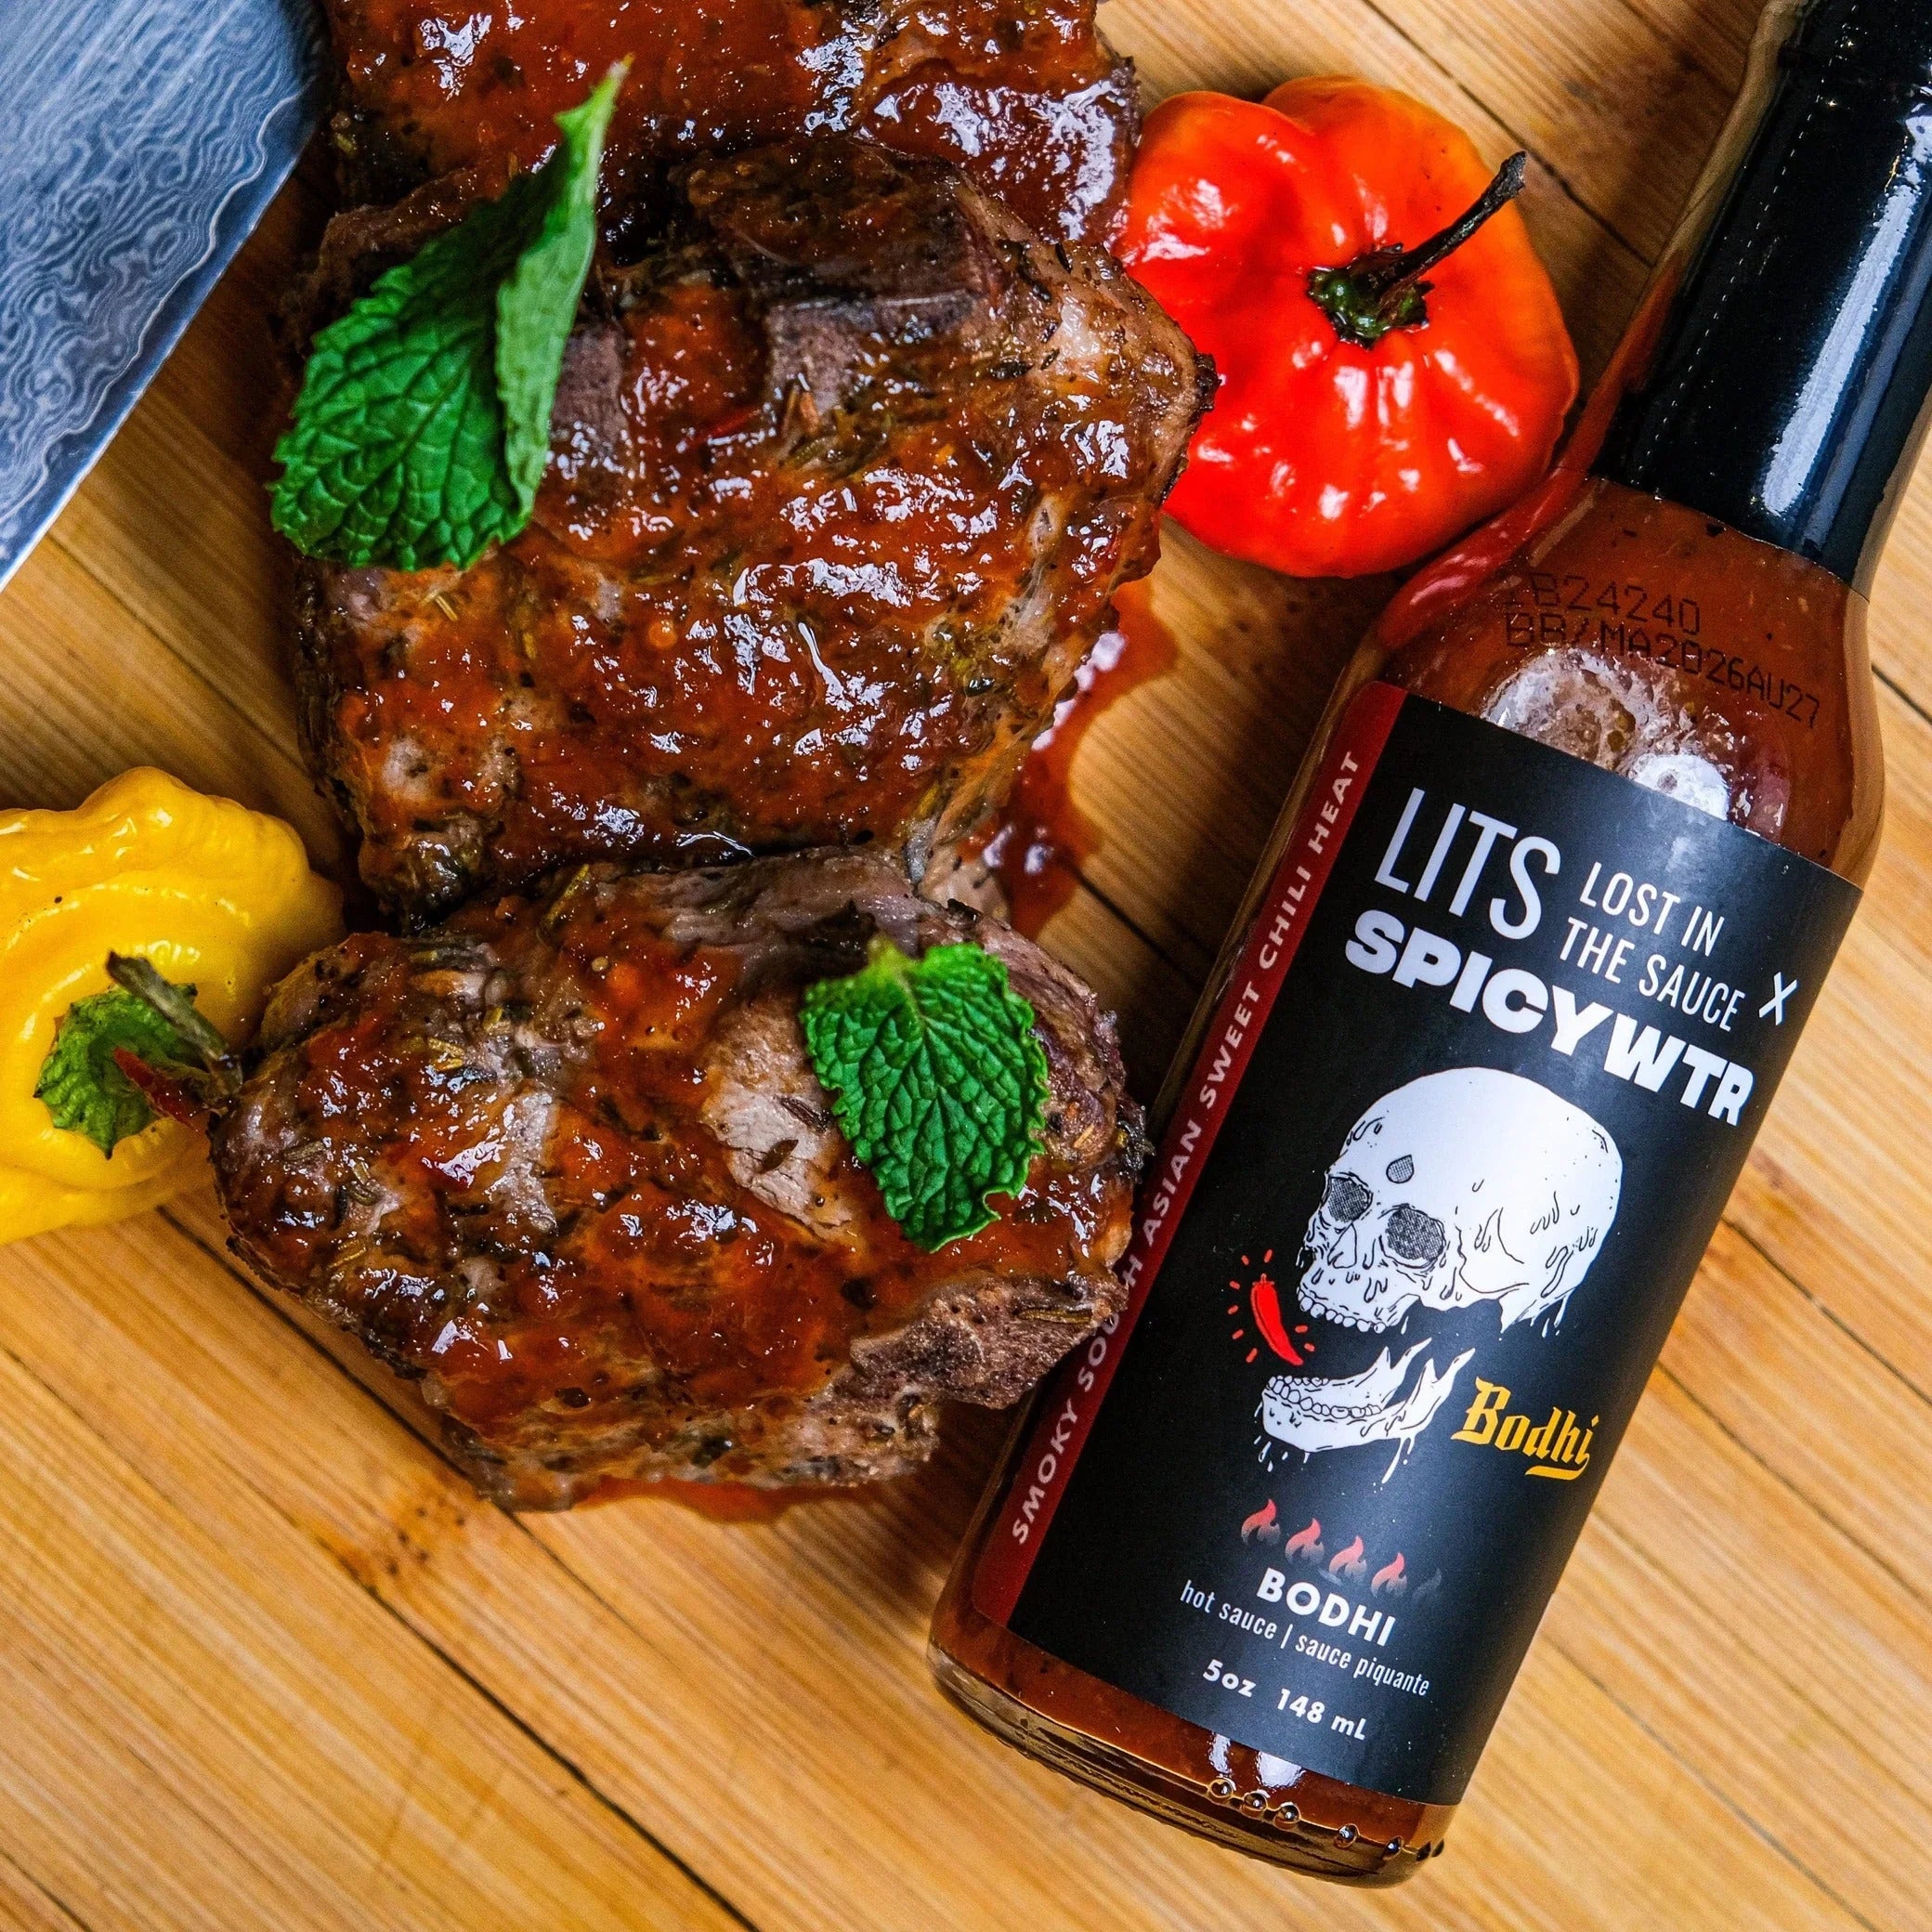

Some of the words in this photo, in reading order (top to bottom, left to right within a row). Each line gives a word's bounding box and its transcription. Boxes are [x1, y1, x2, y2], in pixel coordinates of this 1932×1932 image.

[1375, 787, 1561, 940] LITS
[1580, 861, 1681, 934] LOST
[1680, 906, 1725, 957] IN
[1345, 908, 1756, 1127] SPICYWTR
[1560, 916, 1635, 984] THE
[1638, 953, 1746, 1032] SAUCE
[1012, 1399, 1078, 1546] SMOKY
[1077, 1254, 1142, 1392] SOUH
[1142, 1120, 1202, 1247] ASIAN
[1199, 981, 1261, 1110] SWEET
[1258, 865, 1312, 970] CHILI
[1307, 751, 1360, 855] HEAT
[1450, 1376, 1600, 1481] Bodhi
[1180, 1579, 1216, 1614] hot
[1219, 1601, 1277, 1640] sauce
[1295, 1633, 1351, 1670] sauce
[1352, 1658, 1430, 1697] piquante
[1256, 1567, 1396, 1647] BODHI
[1203, 1659, 1257, 1699] 5oz
[1277, 1687, 1325, 1725] 148
[1331, 1715, 1368, 1742] mL
